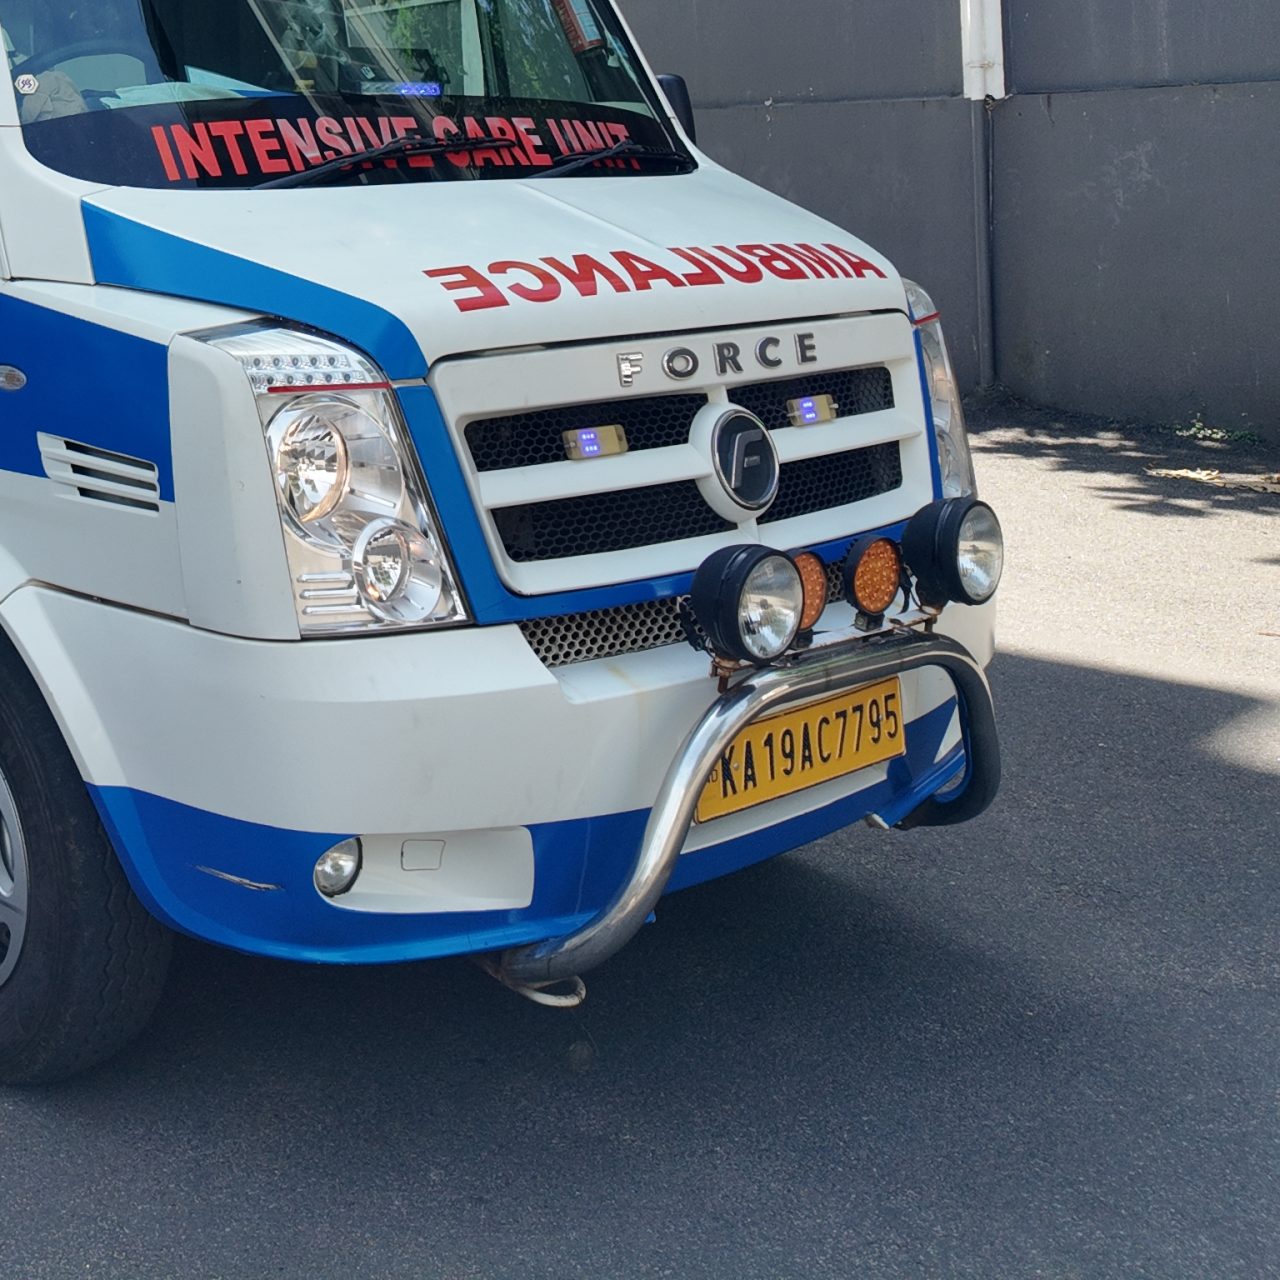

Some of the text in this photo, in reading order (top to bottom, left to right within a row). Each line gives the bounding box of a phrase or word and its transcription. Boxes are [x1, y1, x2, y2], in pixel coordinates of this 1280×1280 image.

[151, 115, 641, 181] INTENSIVE CARE UNIT
[616, 331, 819, 388] FORCE
[720, 692, 899, 799] KA19AC7795
